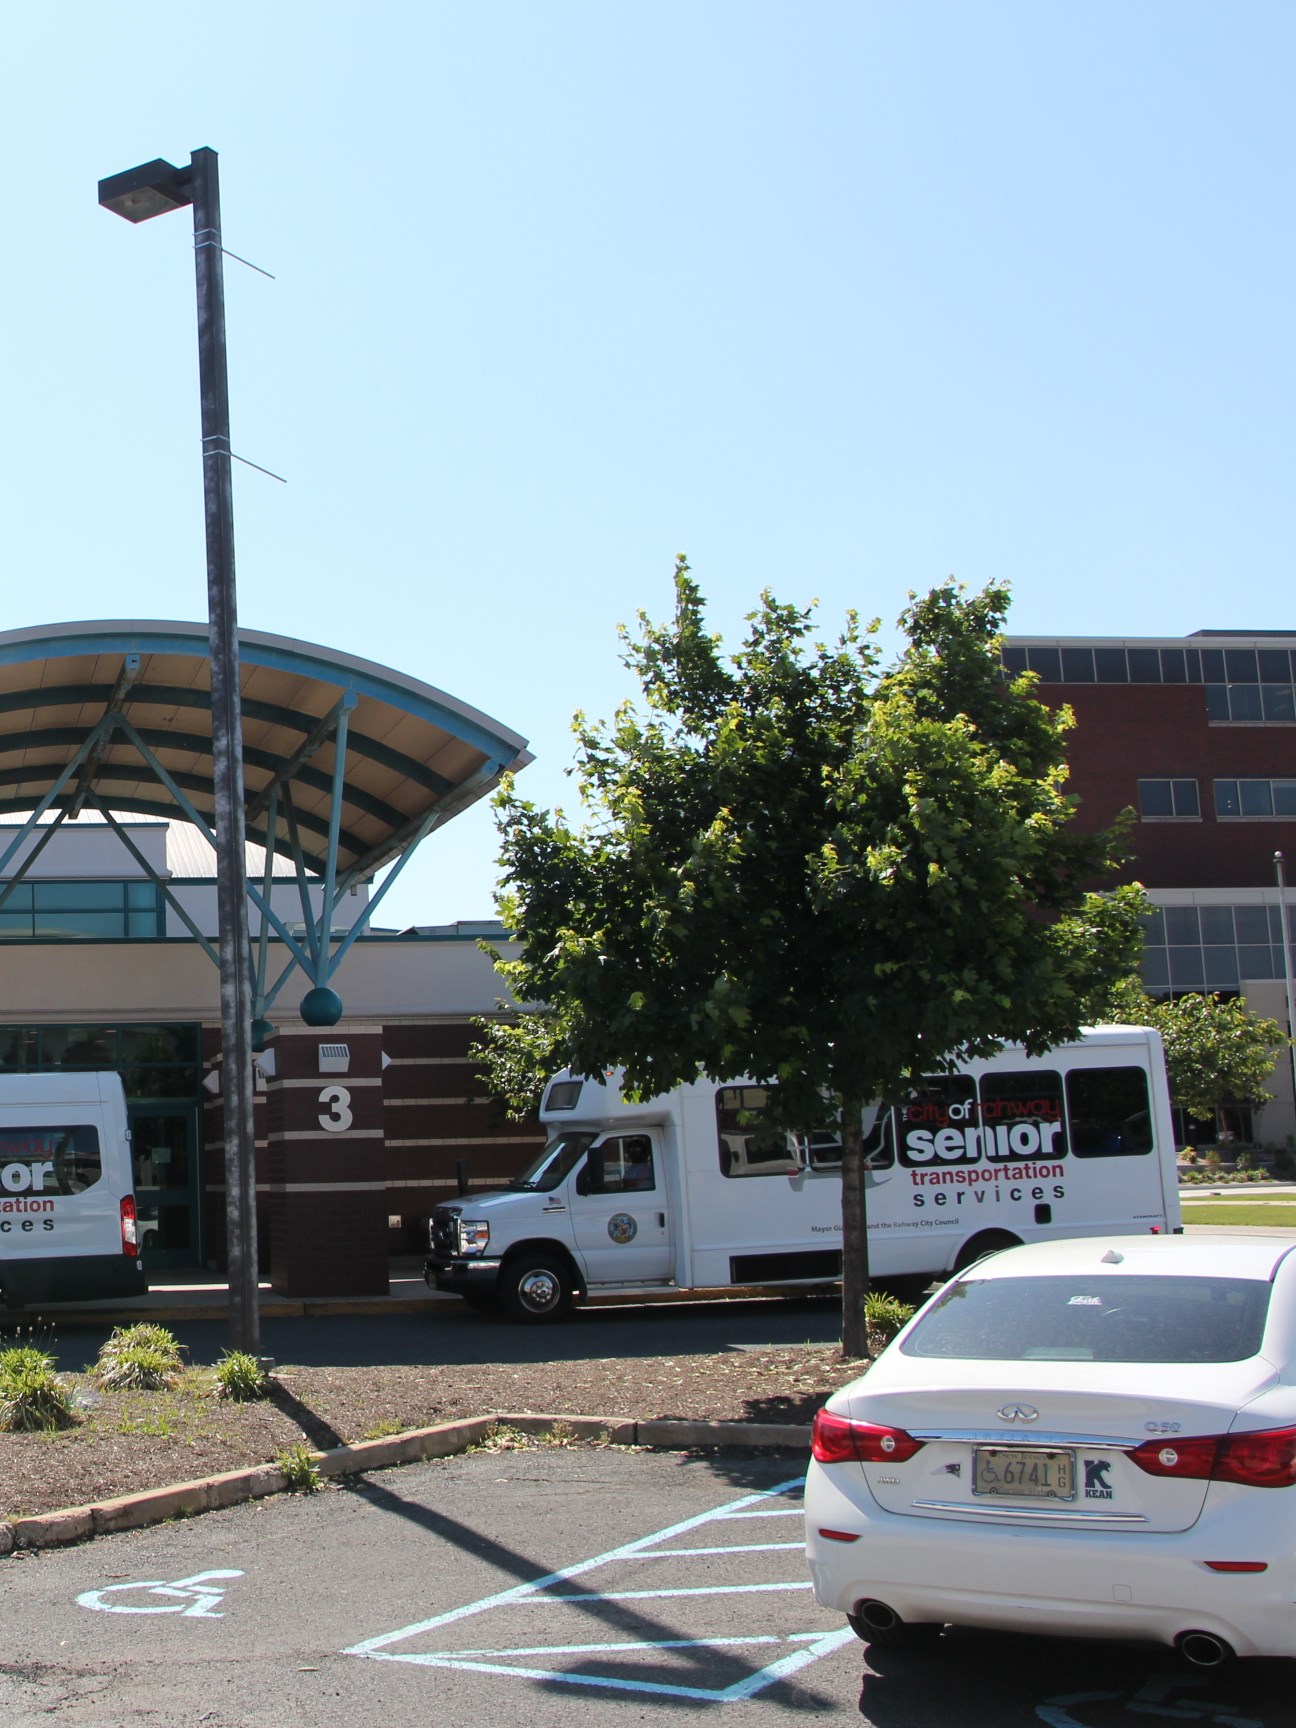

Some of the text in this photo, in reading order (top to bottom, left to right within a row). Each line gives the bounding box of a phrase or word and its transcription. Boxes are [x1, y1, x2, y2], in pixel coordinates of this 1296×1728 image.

[318, 1085, 353, 1132] 3
[909, 1103, 949, 1127] city
[948, 1099, 973, 1119] of
[974, 1099, 1061, 1121] rahway
[906, 1121, 1061, 1162] senior
[910, 1162, 1064, 1186] transportation
[913, 1185, 1064, 1207] services
[893, 1221, 919, 1229] Rahway
[934, 1218, 960, 1226] Council
[1144, 1421, 1182, 1434] Q50
[1004, 1461, 1051, 1487] 6741
[1085, 1489, 1113, 1499] KEAN
